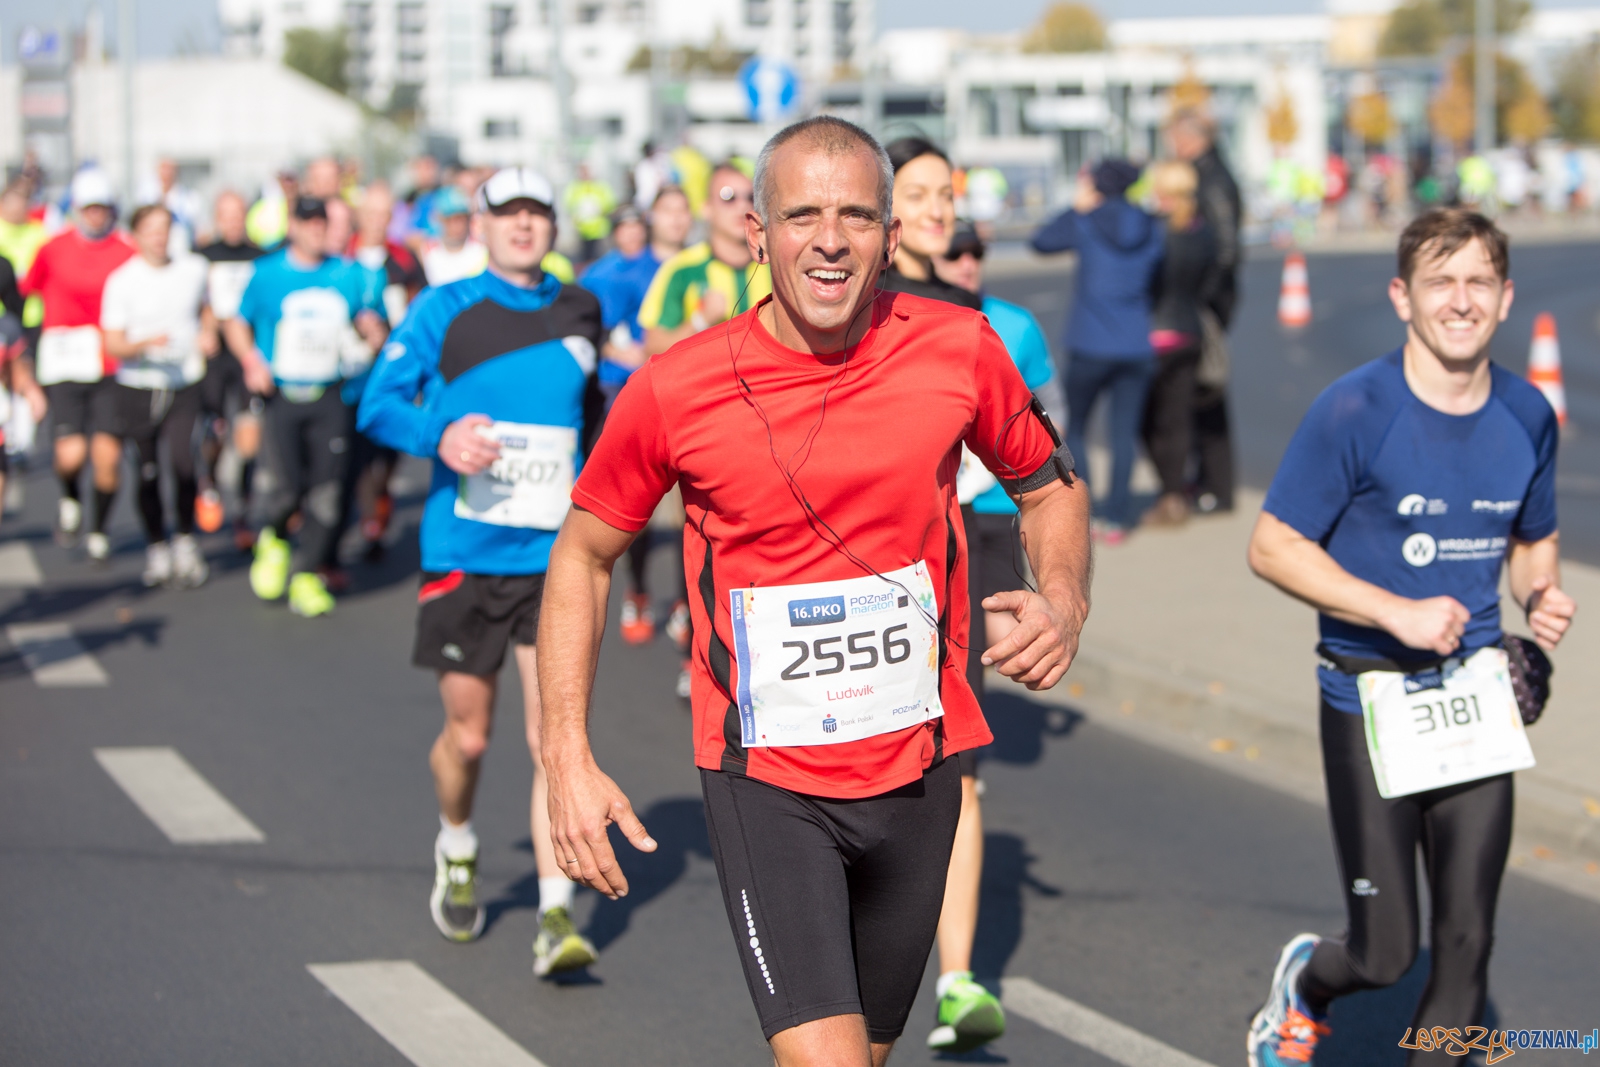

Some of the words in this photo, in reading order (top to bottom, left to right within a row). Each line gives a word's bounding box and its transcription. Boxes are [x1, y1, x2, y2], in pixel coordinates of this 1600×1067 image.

[851, 601, 895, 615] maraton
[780, 623, 911, 681] 2556
[826, 684, 874, 701] Ludwik
[840, 719, 856, 727] Bank
[857, 715, 874, 724] Polski
[1412, 694, 1482, 734] 3181
